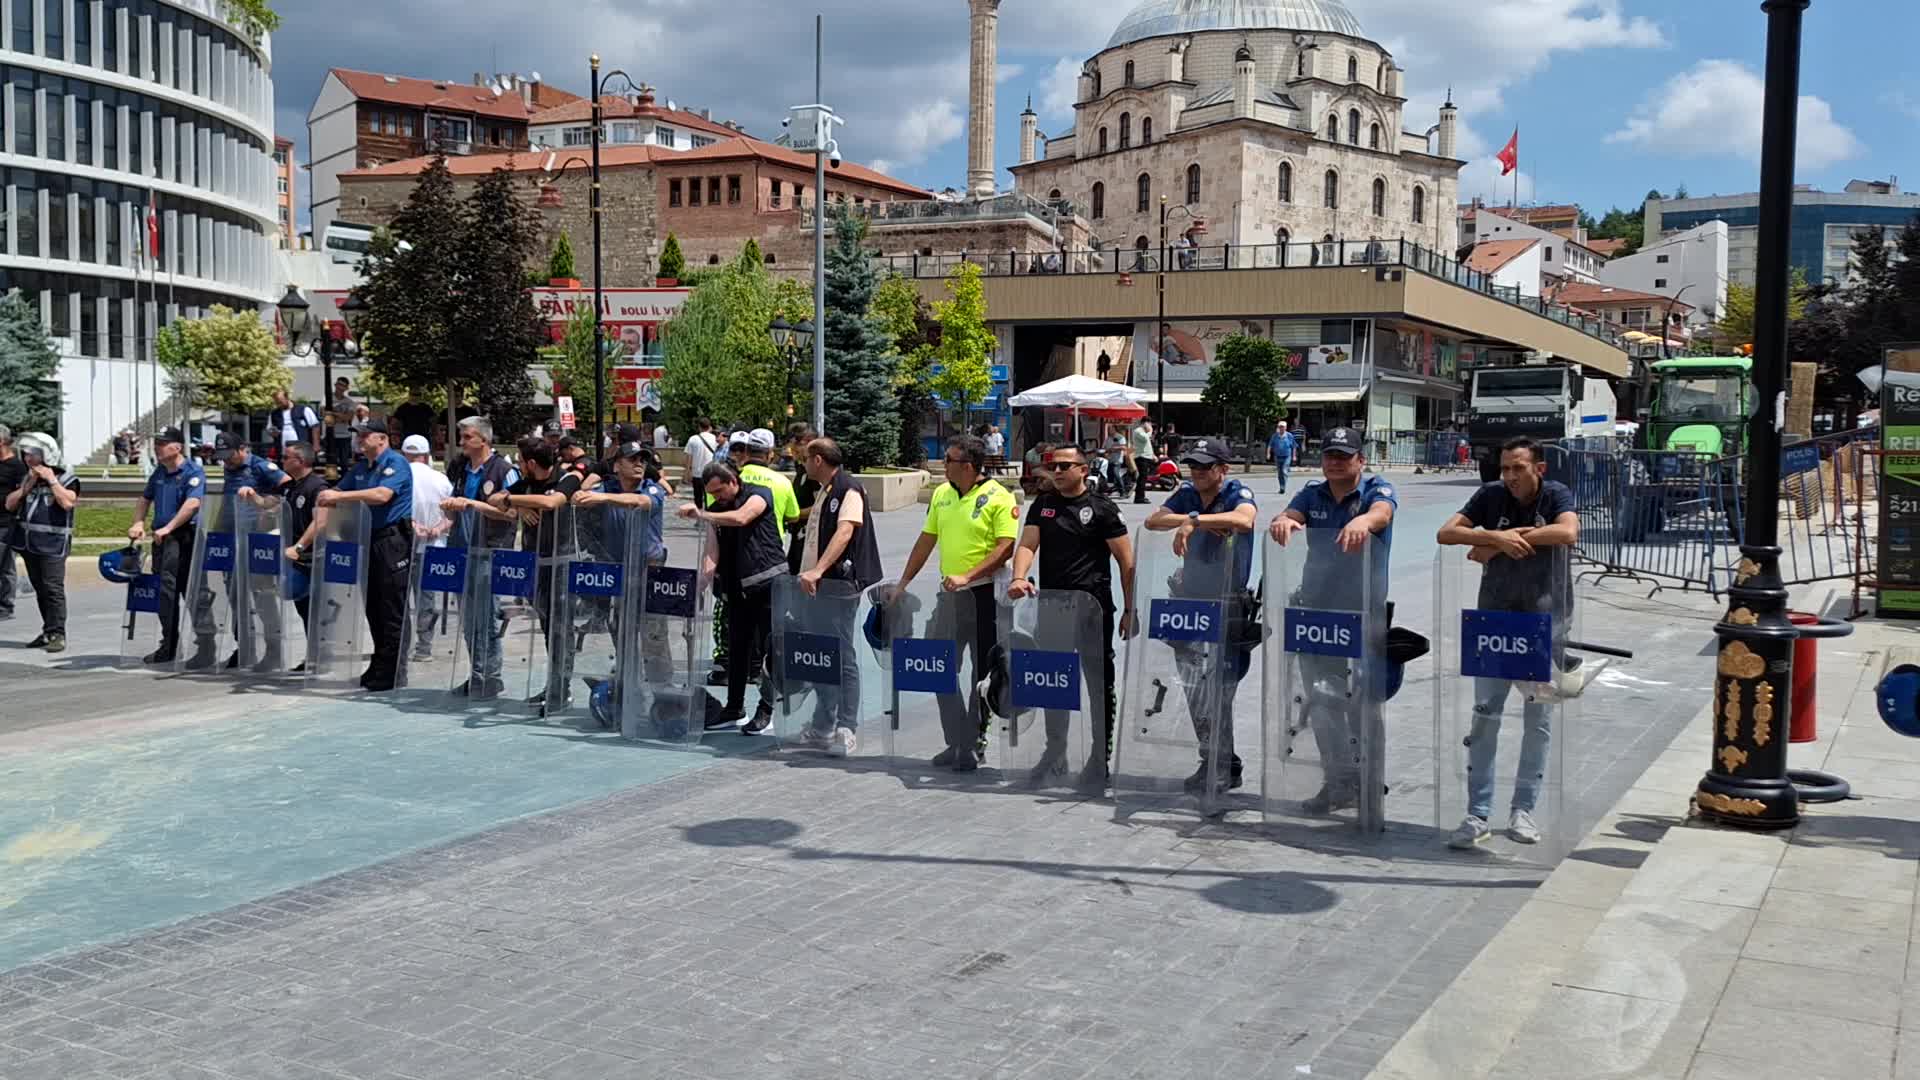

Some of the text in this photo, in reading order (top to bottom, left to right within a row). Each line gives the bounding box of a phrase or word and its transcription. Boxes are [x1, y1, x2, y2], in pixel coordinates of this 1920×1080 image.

[541, 295, 610, 315] PARTİİ
[621, 306, 647, 316] BOLU
[651, 304, 660, 316] İL
[1901, 501, 1920, 513] 21
[209, 546, 229, 558] POLİS
[254, 547, 274, 560] POLİS
[430, 562, 456, 576] POLİS
[500, 564, 526, 579] POLİS
[576, 572, 615, 587] POLİS
[653, 581, 687, 597] POLİS
[1159, 612, 1210, 631] POLİS
[1296, 624, 1351, 646] POLİS
[1477, 635, 1528, 655] POLİS
[794, 651, 832, 667] POLİS
[905, 656, 945, 673] POLİS
[1024, 671, 1069, 688] POLİS
